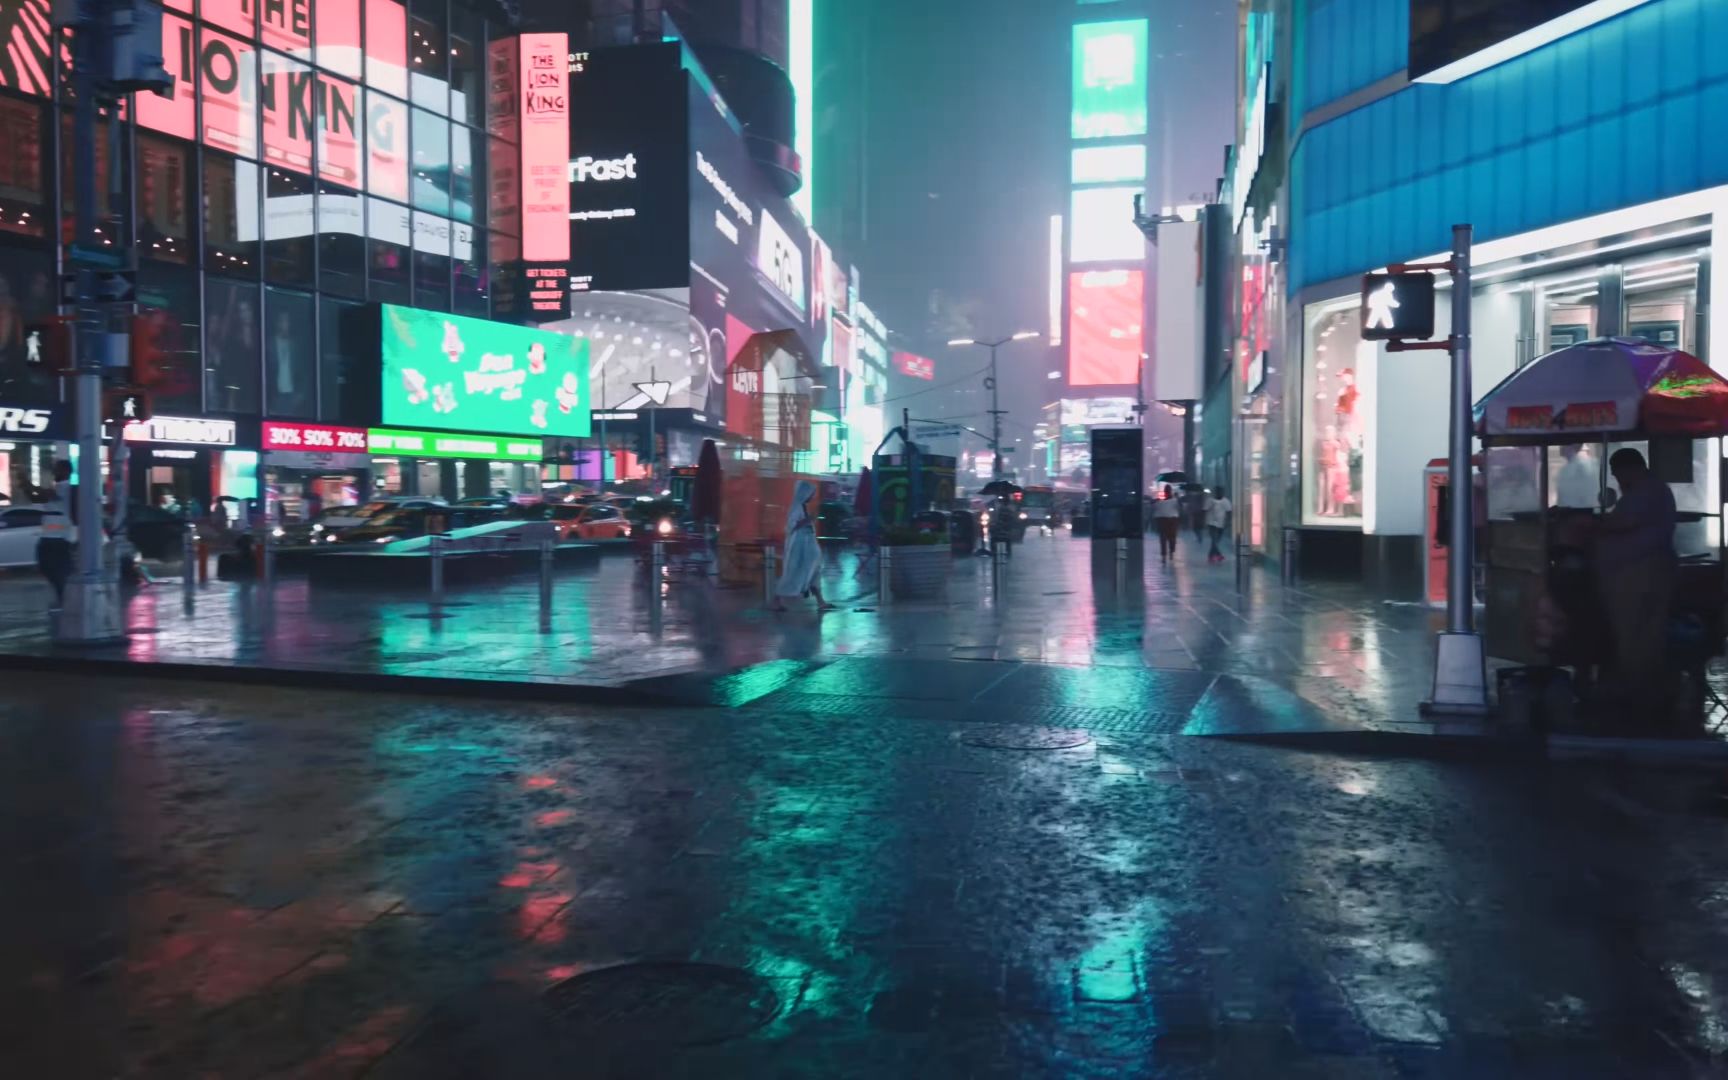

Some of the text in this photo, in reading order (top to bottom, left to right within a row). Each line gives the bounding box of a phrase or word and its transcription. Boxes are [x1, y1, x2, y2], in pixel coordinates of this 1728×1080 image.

[532, 55, 554, 67] THE
[528, 69, 559, 89] LION
[526, 91, 564, 115] KING
[269, 427, 302, 445] 30%
[303, 429, 335, 447] 50%
[336, 431, 366, 448] 70%
